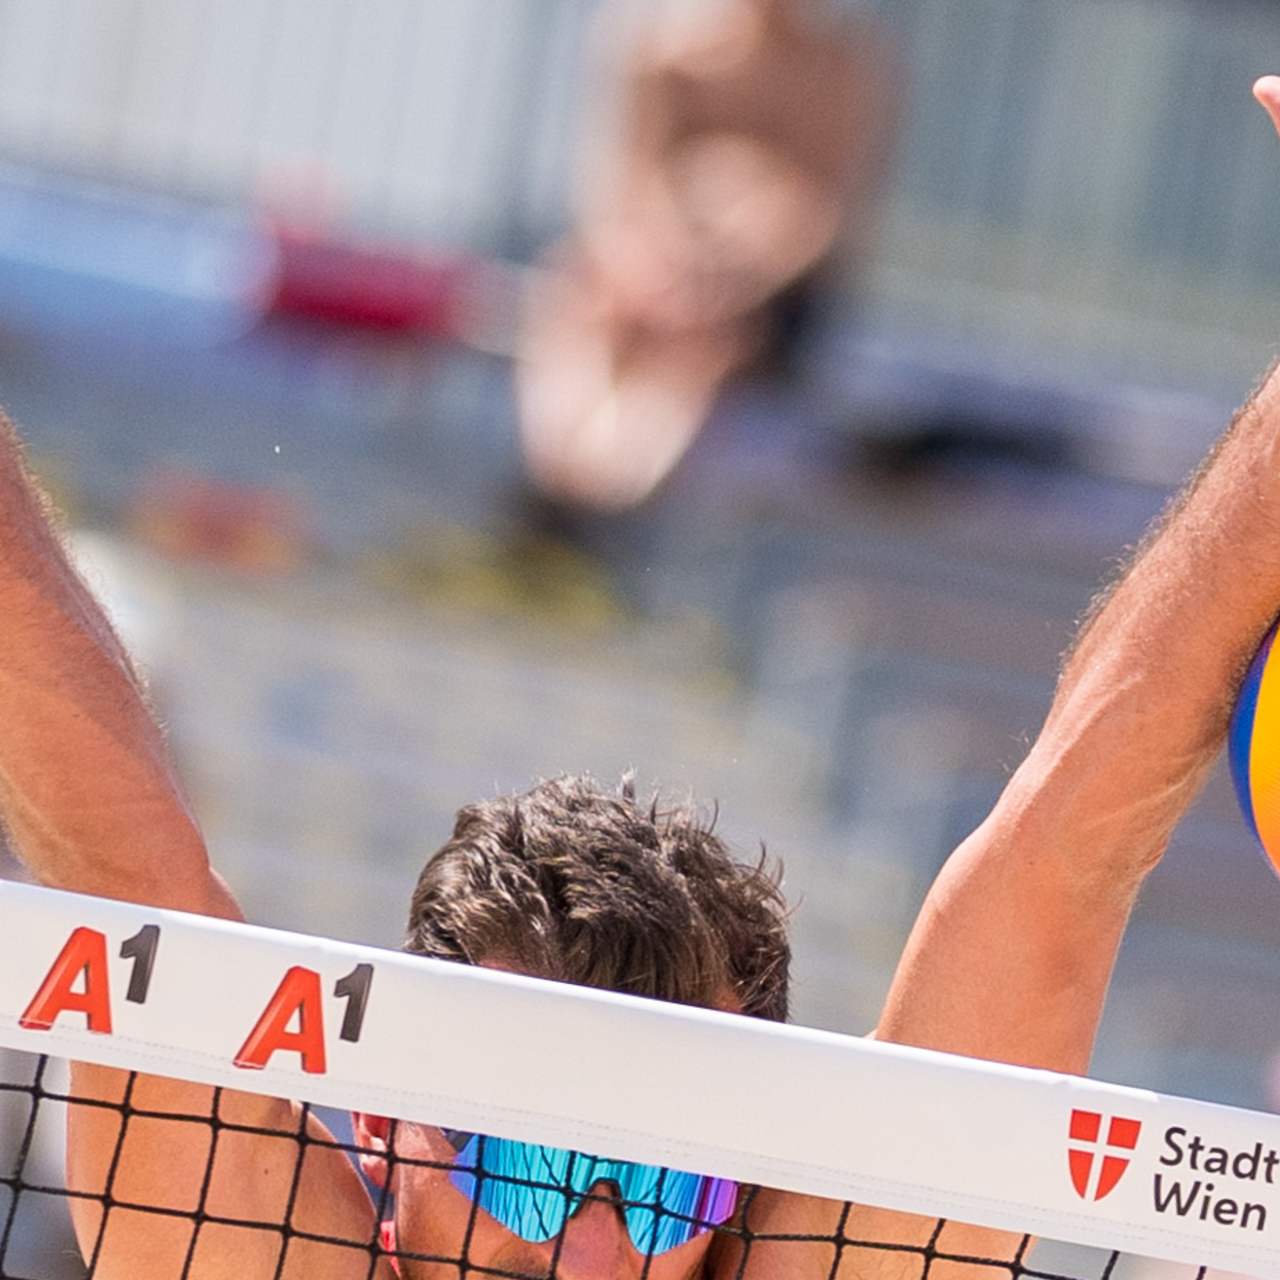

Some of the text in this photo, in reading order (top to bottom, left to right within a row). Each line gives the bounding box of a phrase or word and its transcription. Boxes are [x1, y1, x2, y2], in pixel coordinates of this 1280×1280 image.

[18, 925, 160, 1035] A1
[233, 963, 375, 1074] A1
[1159, 1126, 1280, 1185] Stadt
[1152, 1174, 1268, 1232] Wien
